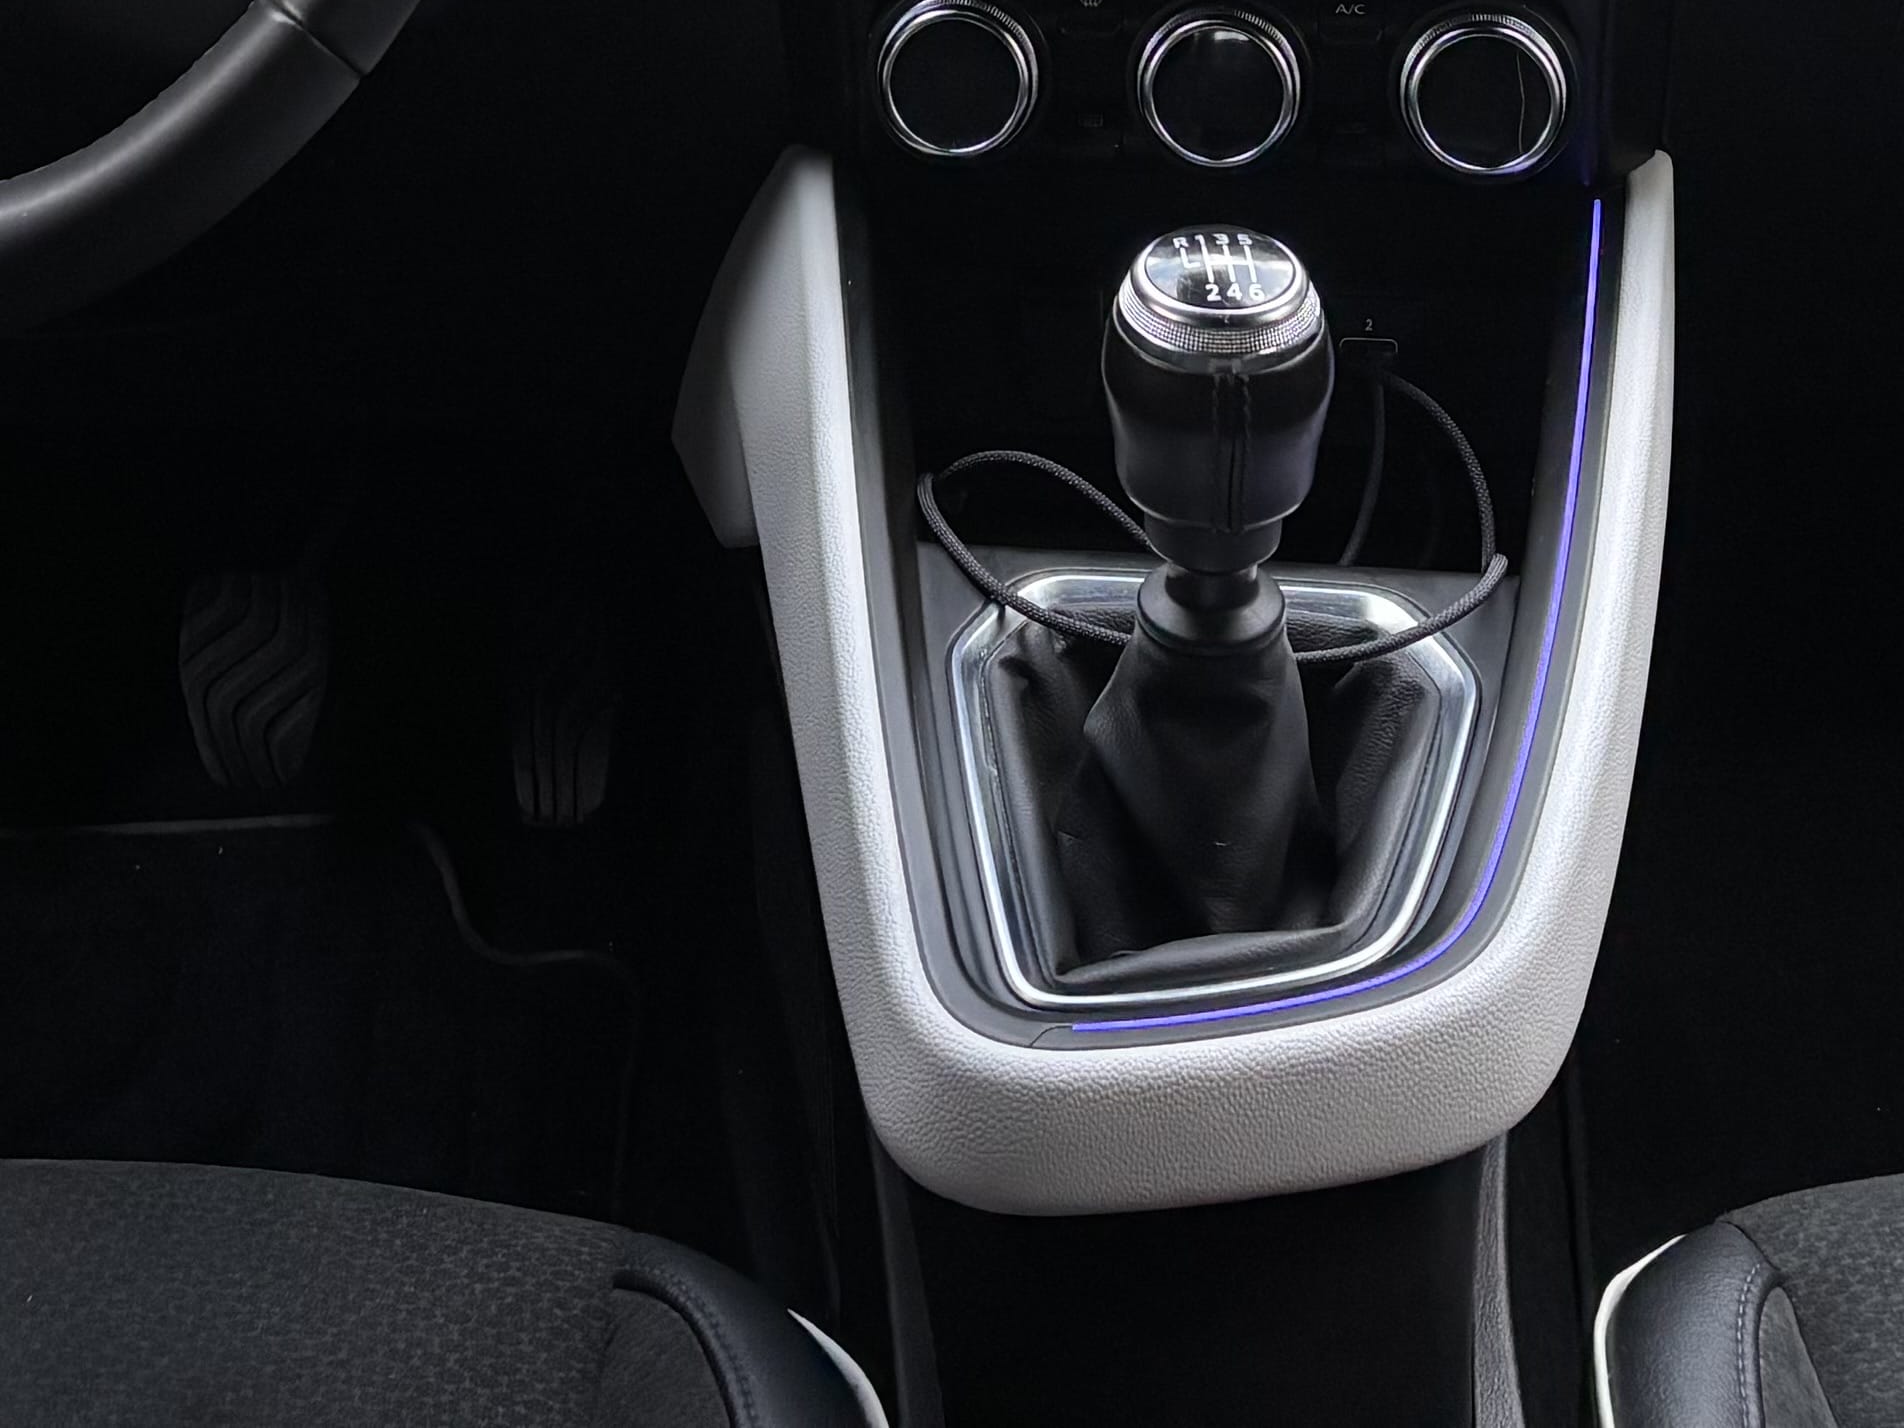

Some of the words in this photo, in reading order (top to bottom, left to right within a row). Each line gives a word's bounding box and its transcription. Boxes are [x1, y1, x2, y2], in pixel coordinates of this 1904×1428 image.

[1336, 3, 1366, 15] A/C
[1173, 236, 1190, 248] R
[1213, 233, 1229, 245] 3
[1237, 234, 1253, 246] 5
[1205, 284, 1221, 302] 2
[1226, 283, 1243, 301] 4
[1249, 283, 1265, 301] 6
[1365, 318, 1373, 332] 2
